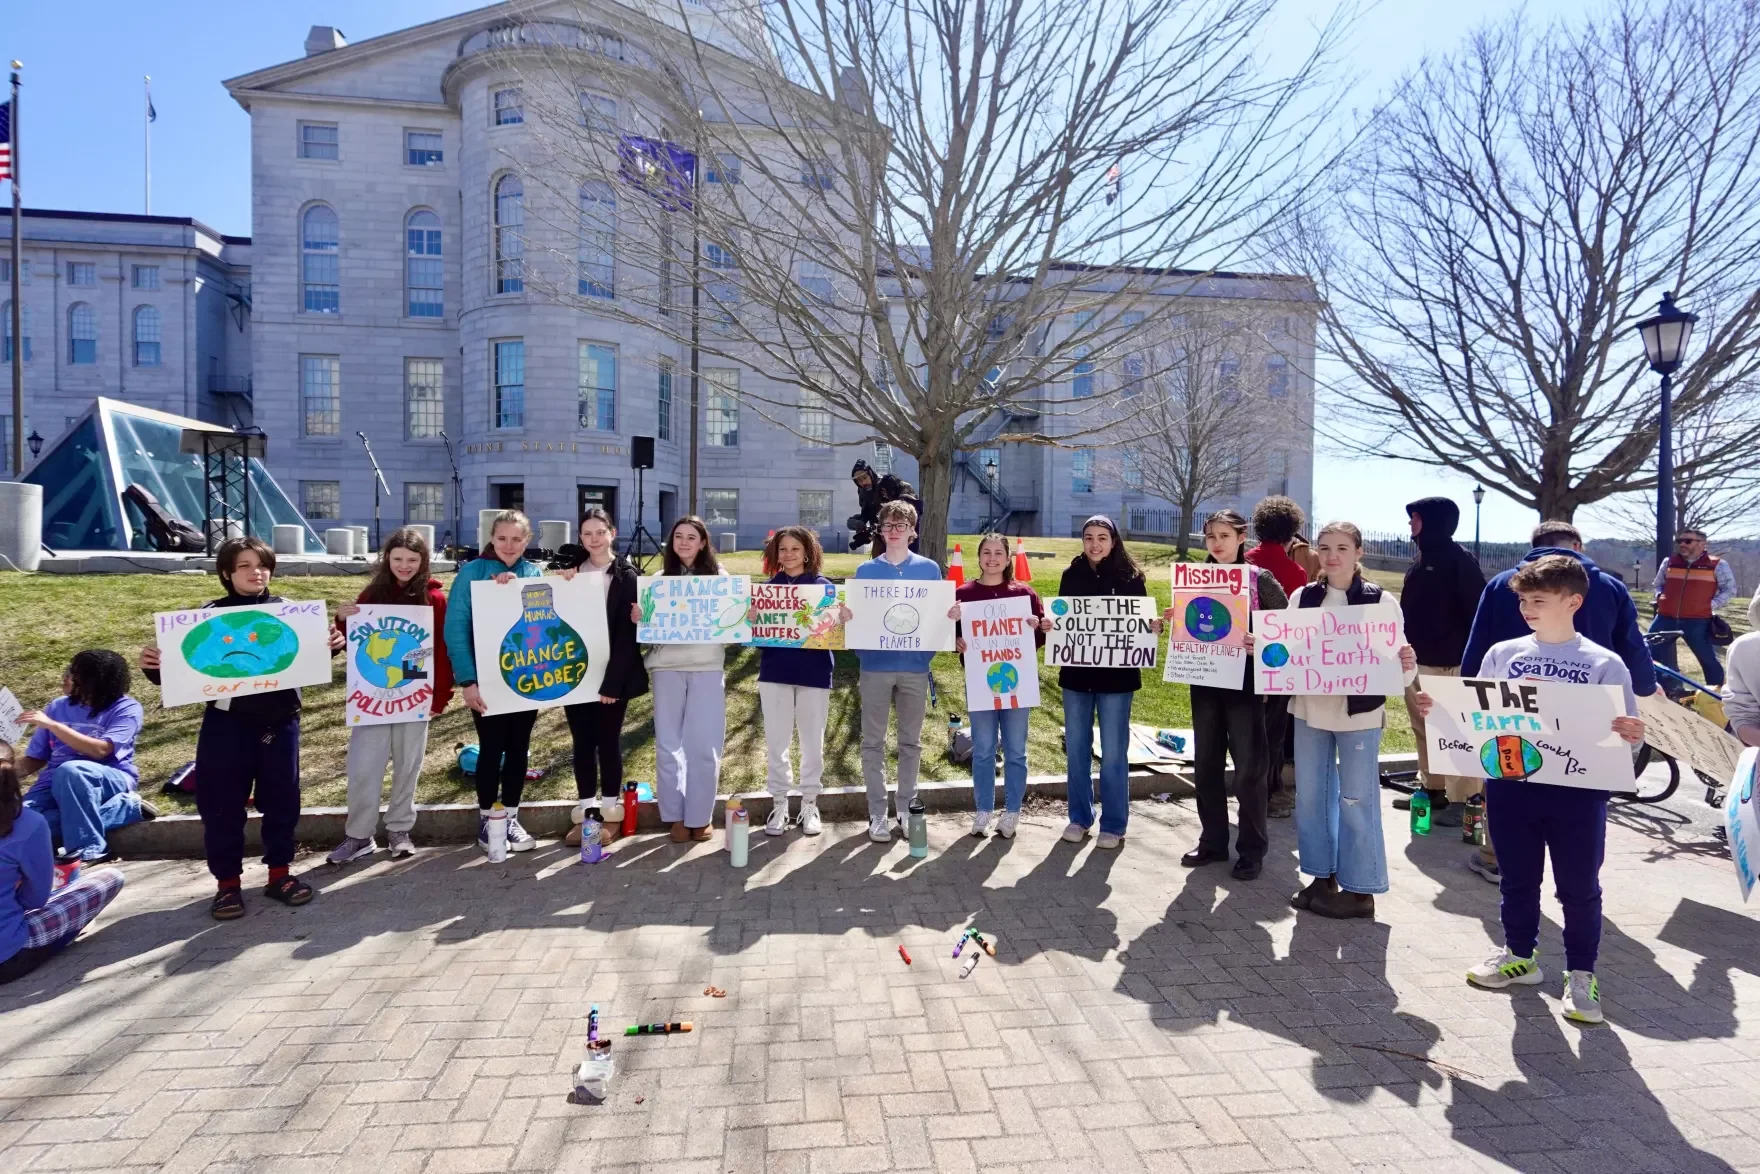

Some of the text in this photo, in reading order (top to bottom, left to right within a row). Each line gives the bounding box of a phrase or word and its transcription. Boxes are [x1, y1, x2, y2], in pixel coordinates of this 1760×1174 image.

[466, 441, 632, 456] MAINE STATE HOU
[1175, 563, 1242, 595] Missing
[527, 591, 546, 599] HOW
[650, 577, 743, 598] CHANGE
[751, 585, 798, 599] LASTIC
[864, 586, 928, 599] THERE IS NO
[276, 603, 320, 617] save
[687, 598, 720, 613] THE
[751, 598, 807, 610] ODUCERS
[984, 603, 1008, 619] OUR
[1072, 598, 1141, 615] BE THE
[524, 608, 556, 623] HUMANS
[756, 612, 788, 624] ANET
[349, 616, 430, 647] SOLUTION
[752, 626, 800, 640] LLUTERS
[1053, 617, 1153, 634] SOLUTION
[1262, 611, 1397, 650] Stop Denying
[880, 635, 921, 649] PLANET B
[971, 637, 1020, 650] IS IN OUR
[1066, 633, 1135, 649] NOT THE
[501, 640, 575, 671] CHANGE
[981, 647, 1022, 663] HANDS
[1053, 644, 1155, 667] POLLUTION
[1173, 642, 1242, 658] HEALTHY PLANET
[1322, 640, 1380, 666] Earth
[518, 662, 586, 693] GLOBE?
[1507, 661, 1590, 684] Sea Dogs
[1262, 668, 1368, 694] Is Dying
[347, 683, 433, 717] POLLUTION
[1438, 738, 1474, 753] Before
[1565, 757, 1587, 775] Be
